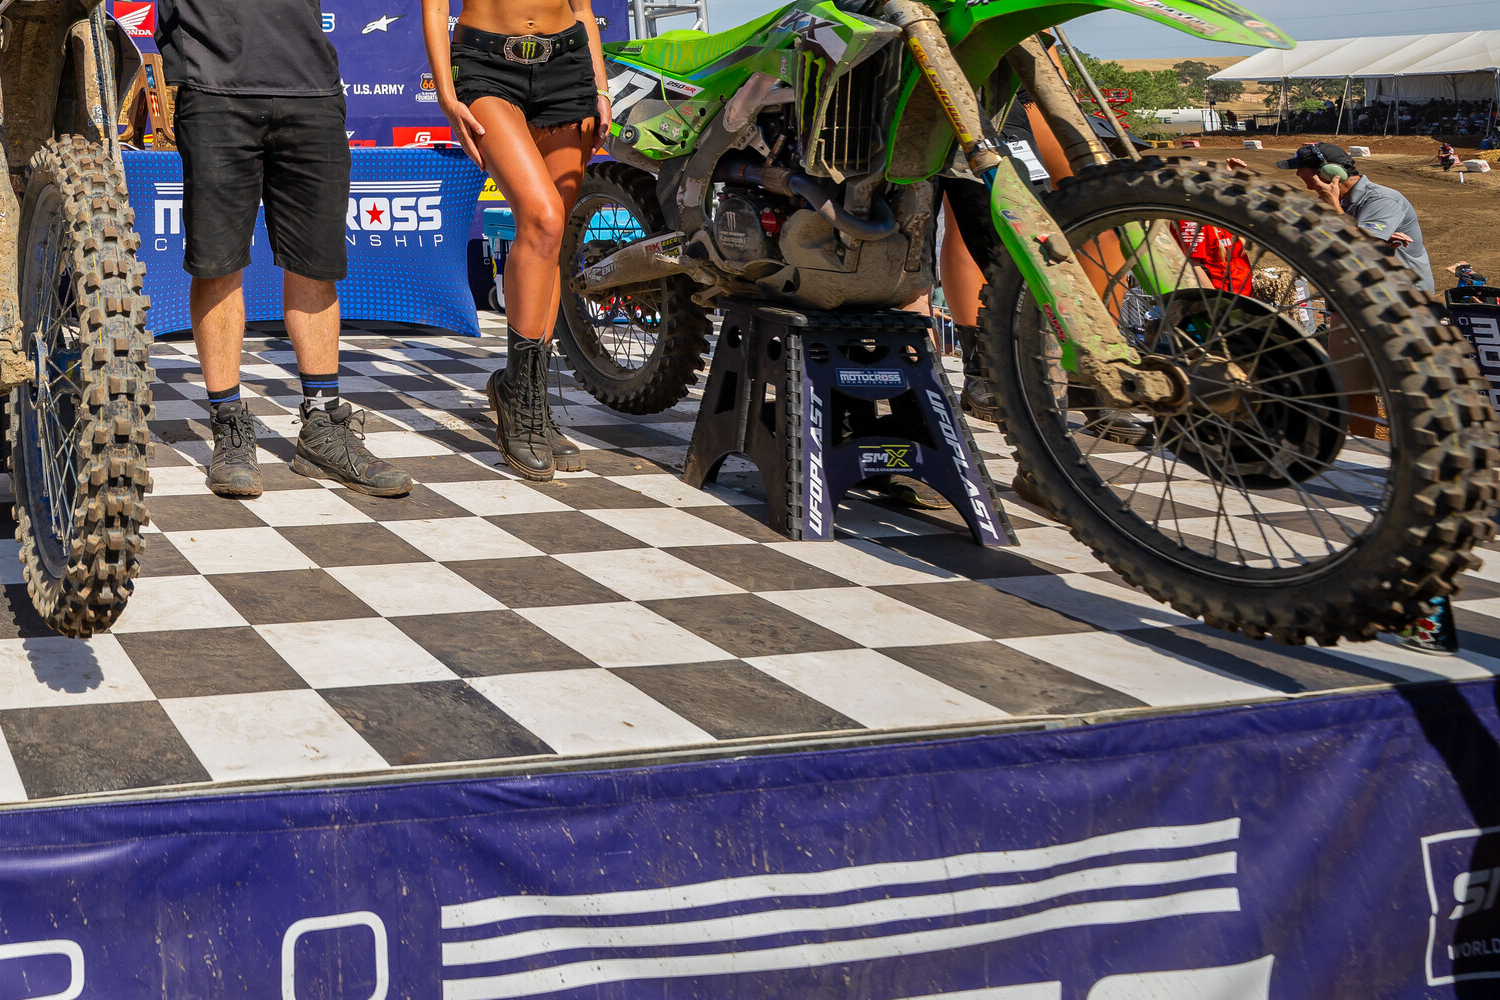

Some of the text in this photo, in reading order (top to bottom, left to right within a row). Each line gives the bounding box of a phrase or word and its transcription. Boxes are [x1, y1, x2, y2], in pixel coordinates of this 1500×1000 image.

[777, 8, 845, 44] KX
[353, 84, 405, 95] U.S. ARMY
[422, 80, 435, 89] 66
[666, 79, 697, 94] 250SR
[839, 372, 902, 382] MOTOCROSS
[809, 386, 824, 537] UFOPLAST
[861, 448, 911, 468] SMX
[925, 388, 1000, 541] UFOPLAST
